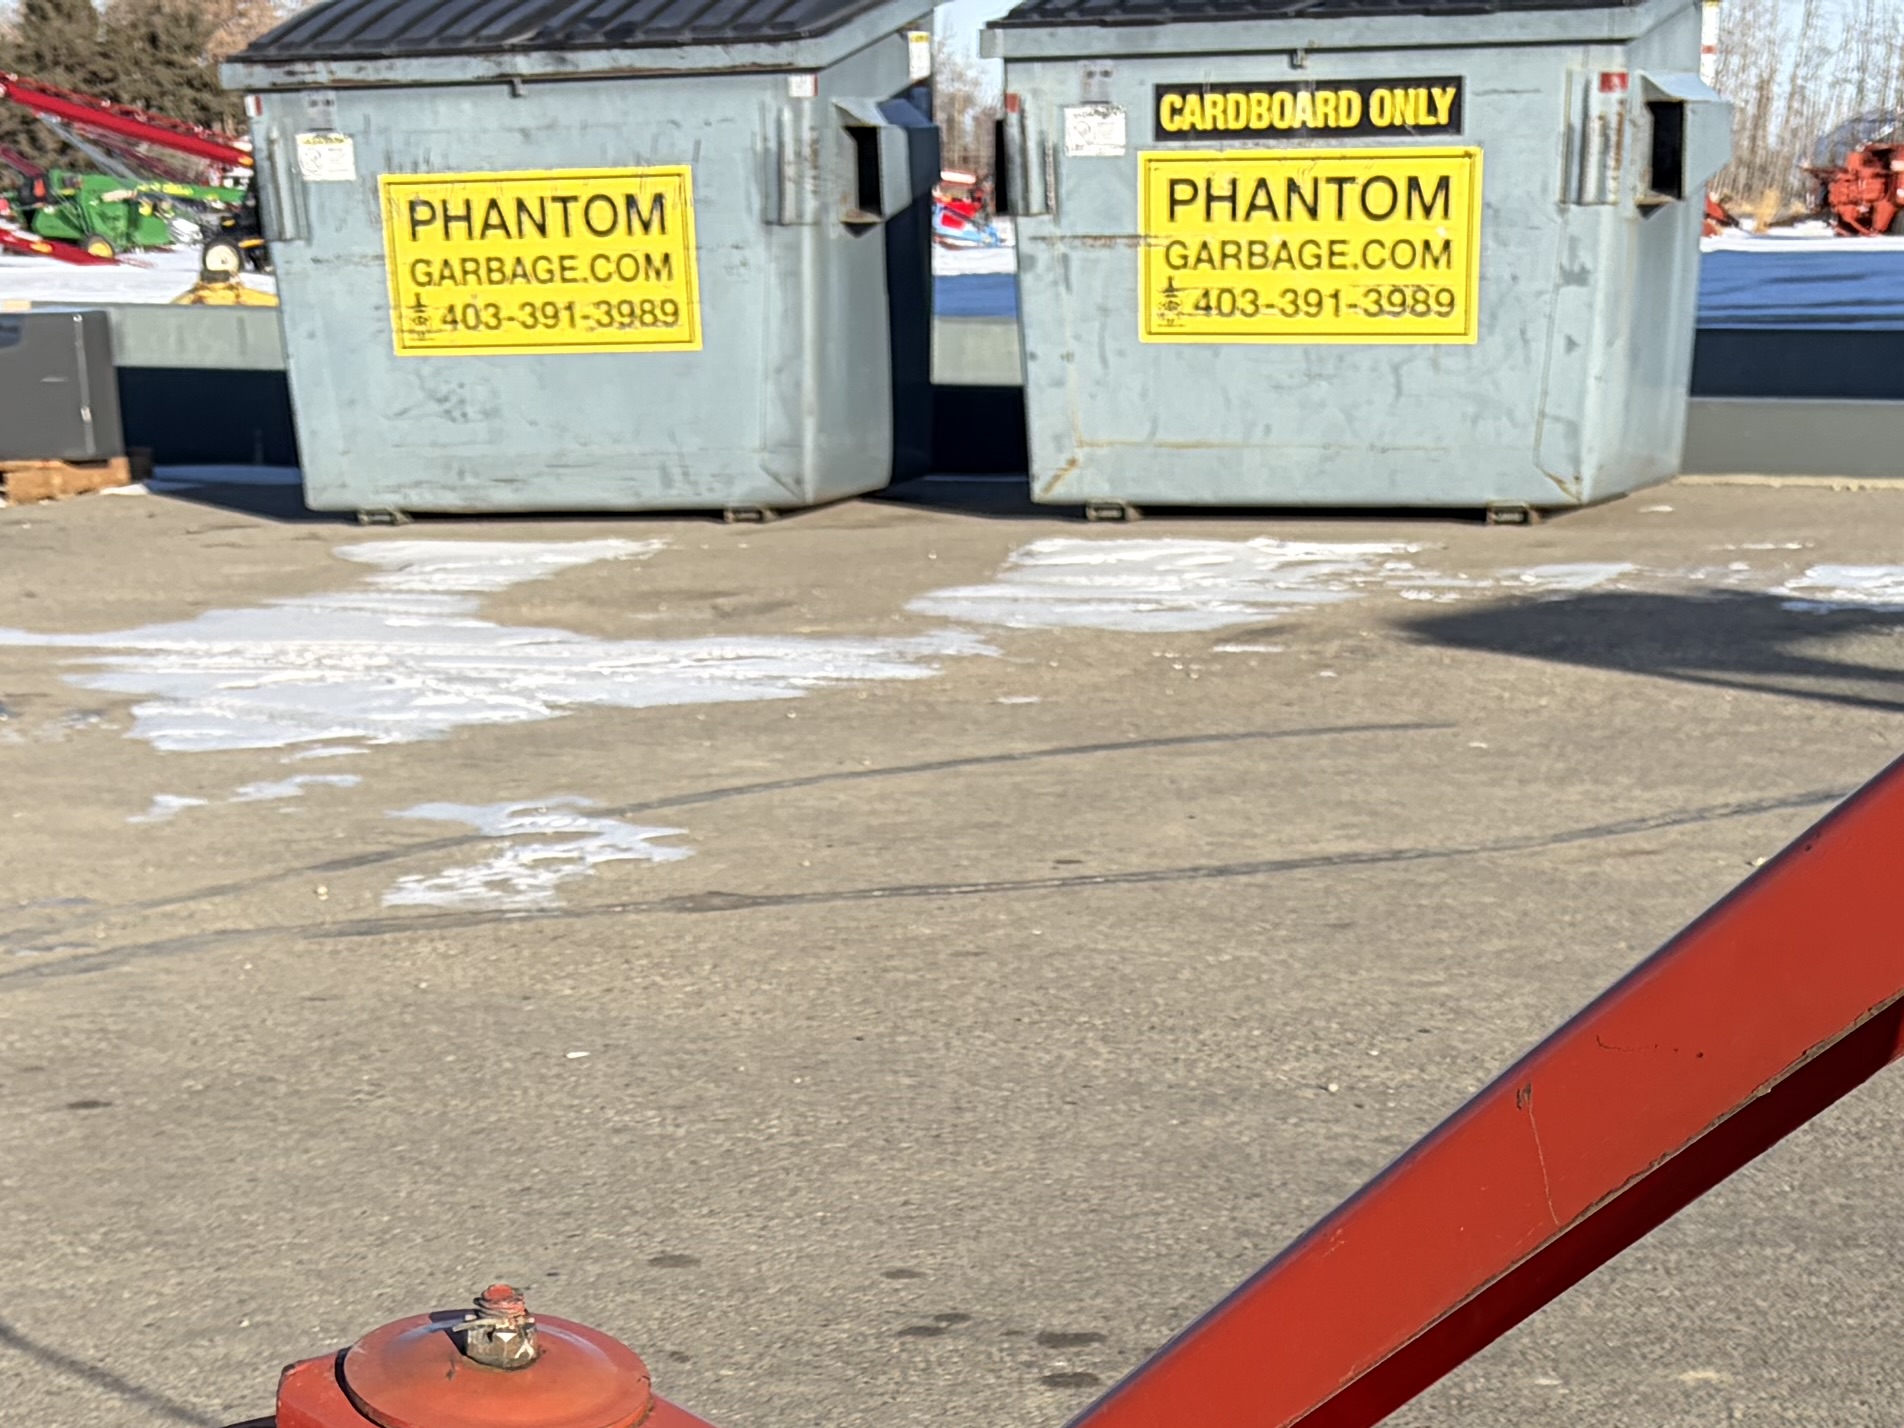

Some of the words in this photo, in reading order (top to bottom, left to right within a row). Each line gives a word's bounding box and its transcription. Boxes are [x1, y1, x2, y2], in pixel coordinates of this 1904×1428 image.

[1159, 90, 1363, 131] CARDBOARD
[1369, 87, 1456, 127] ONLY
[1168, 175, 1451, 222] PHANTOM
[407, 192, 667, 241] PHANTOM
[410, 252, 674, 287] GARBAGE.COM
[1164, 239, 1453, 271] GARBAGE.COM
[442, 299, 680, 331] 403-391-3989
[1192, 288, 1456, 319] 403-391-3989
